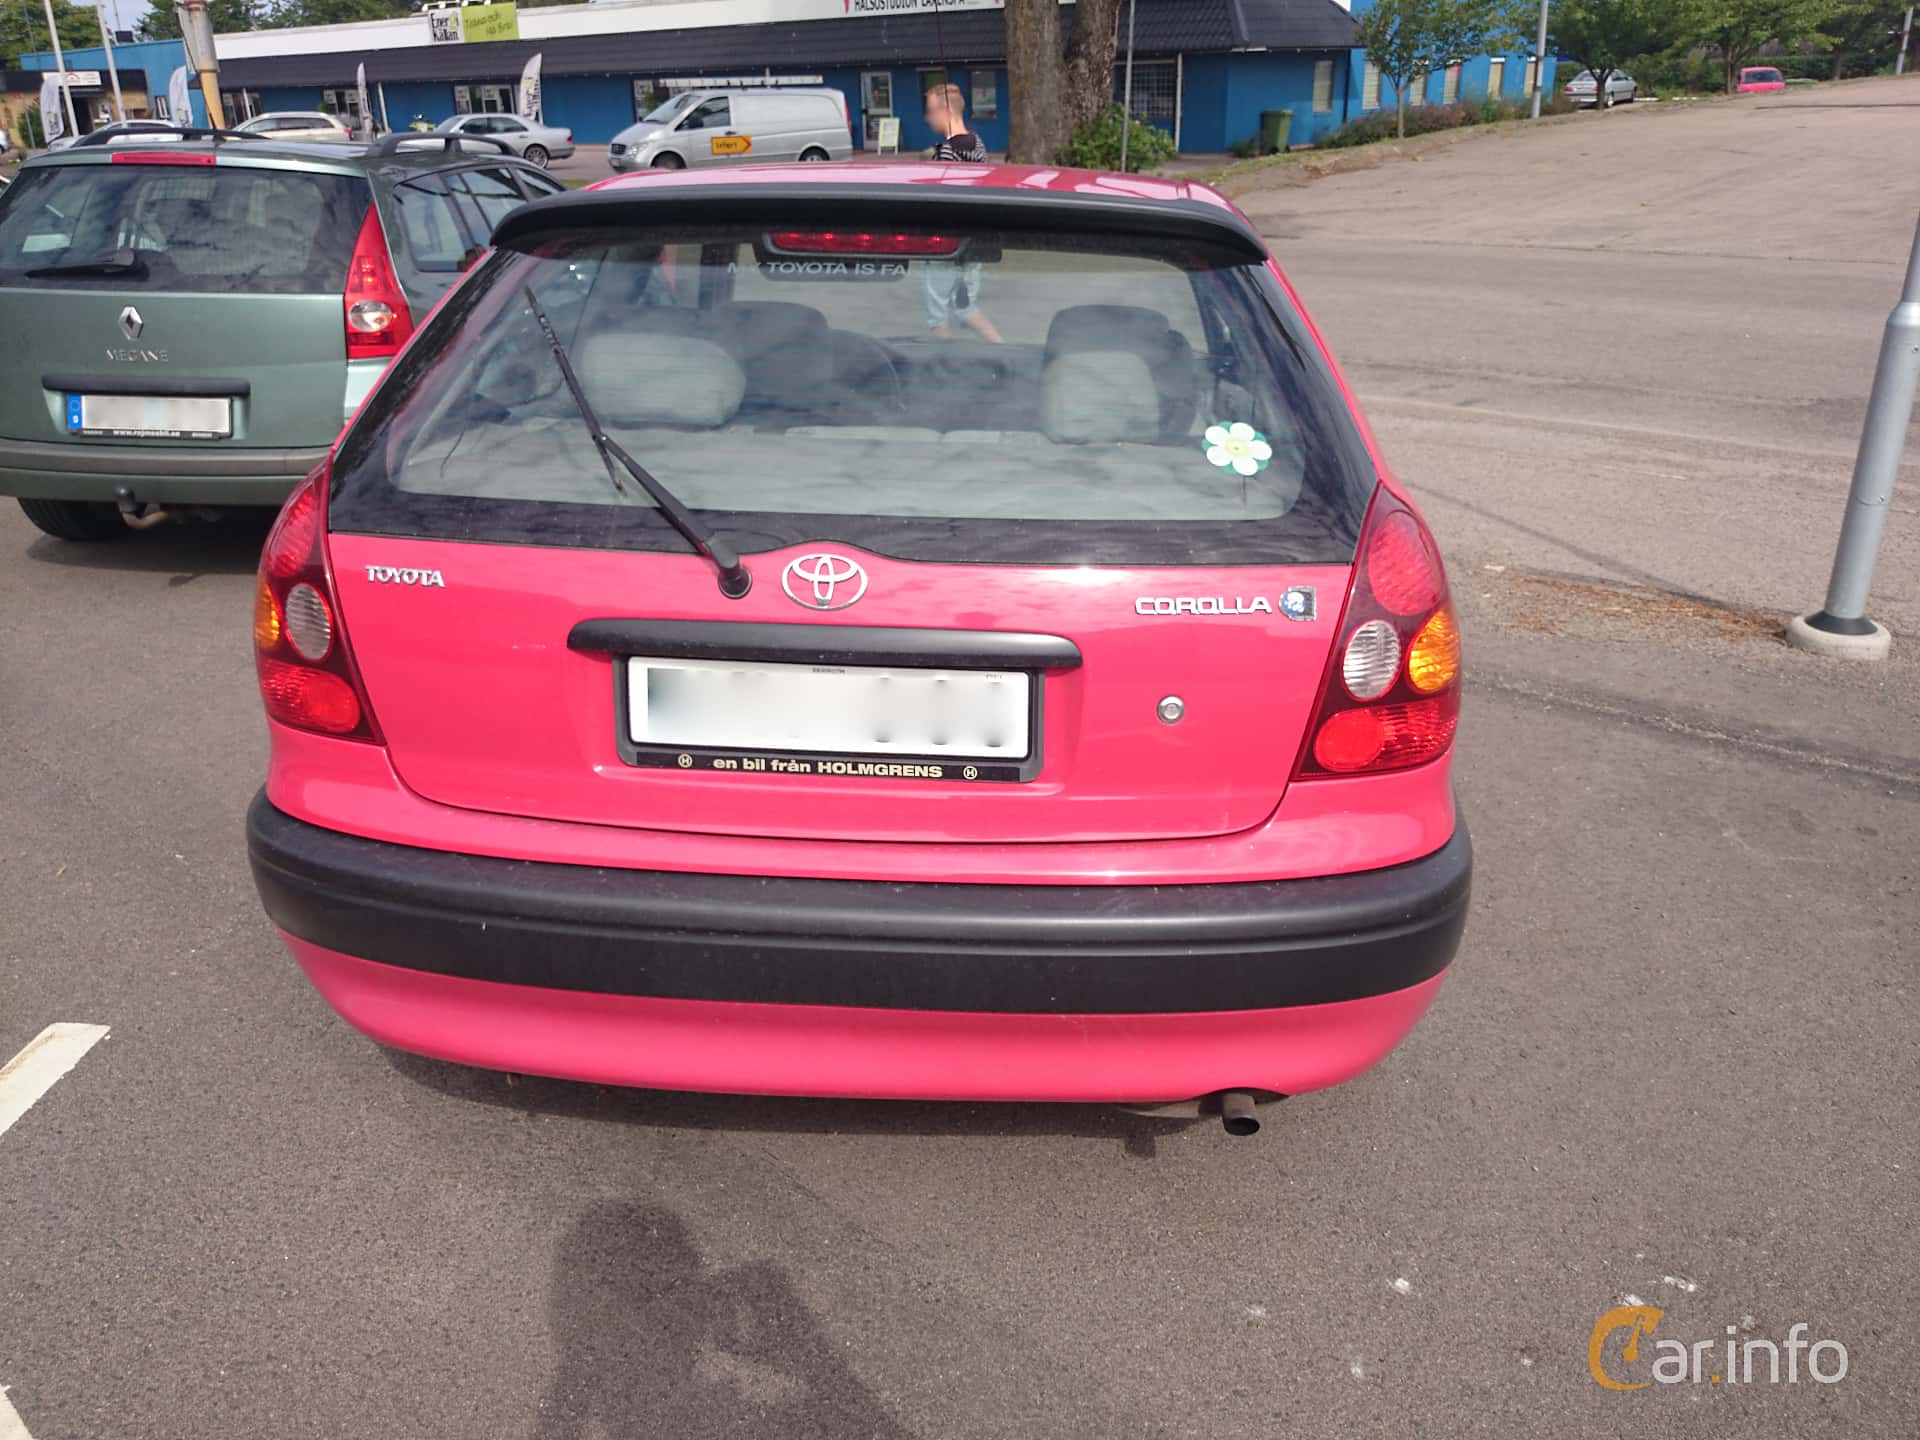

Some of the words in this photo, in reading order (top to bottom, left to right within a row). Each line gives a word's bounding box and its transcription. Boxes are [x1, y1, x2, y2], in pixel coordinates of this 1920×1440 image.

[767, 262, 848, 274] TOYOTA
[855, 263, 876, 275] IS
[880, 263, 908, 276] FA
[106, 349, 169, 362] MEGANE
[365, 565, 445, 588] TOYOTA
[1135, 596, 1273, 615] COROLLA
[713, 758, 738, 769] en
[743, 758, 765, 771] bil
[770, 759, 812, 773] från
[818, 760, 943, 778] HOLMGRENS
